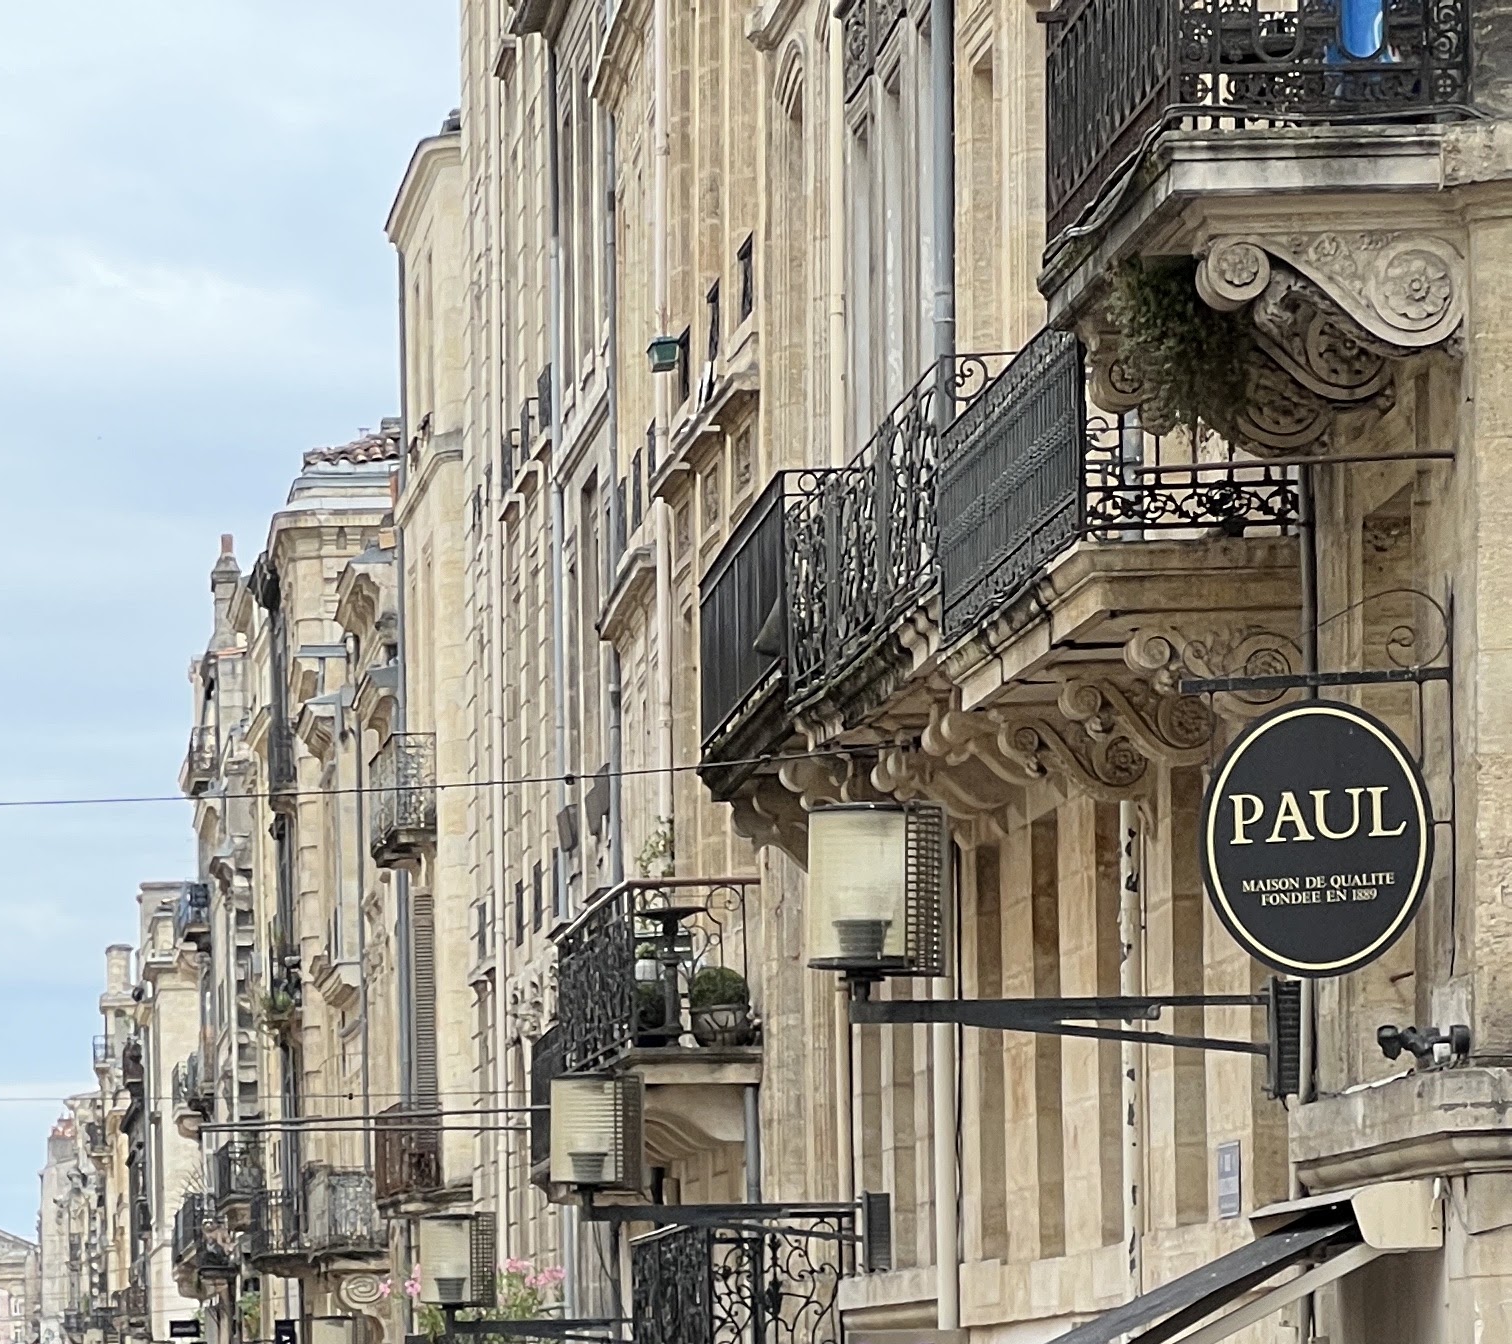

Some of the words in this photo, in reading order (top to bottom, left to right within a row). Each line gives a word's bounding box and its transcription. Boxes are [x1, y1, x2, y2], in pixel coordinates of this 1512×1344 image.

[1229, 786, 1407, 845] PAUL
[1242, 876, 1300, 893] MAISON
[1306, 875, 1326, 889] DE
[1330, 872, 1395, 887] QUALITE
[1261, 891, 1321, 907] FONDEE
[1326, 889, 1347, 902] EN
[1352, 888, 1378, 901] 1889
